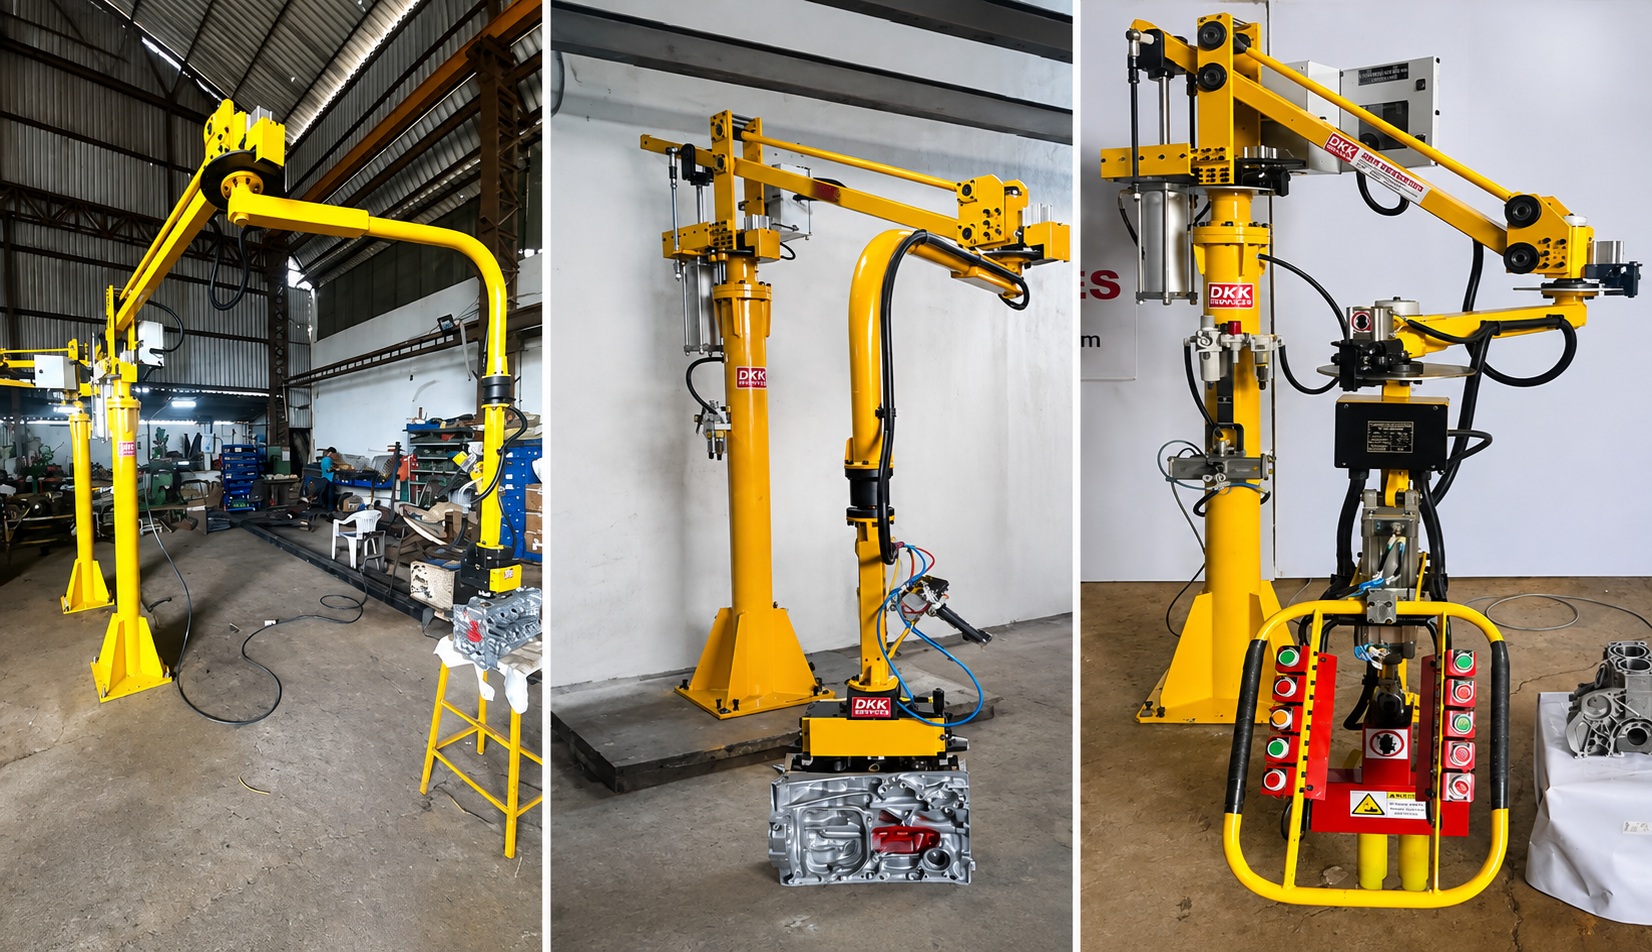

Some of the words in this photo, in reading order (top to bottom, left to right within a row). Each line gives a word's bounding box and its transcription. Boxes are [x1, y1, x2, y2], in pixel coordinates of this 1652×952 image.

[1328, 136, 1357, 159] DKK
[1210, 286, 1251, 299] DKK
[739, 370, 766, 380] DKK
[855, 699, 888, 710] DKK
